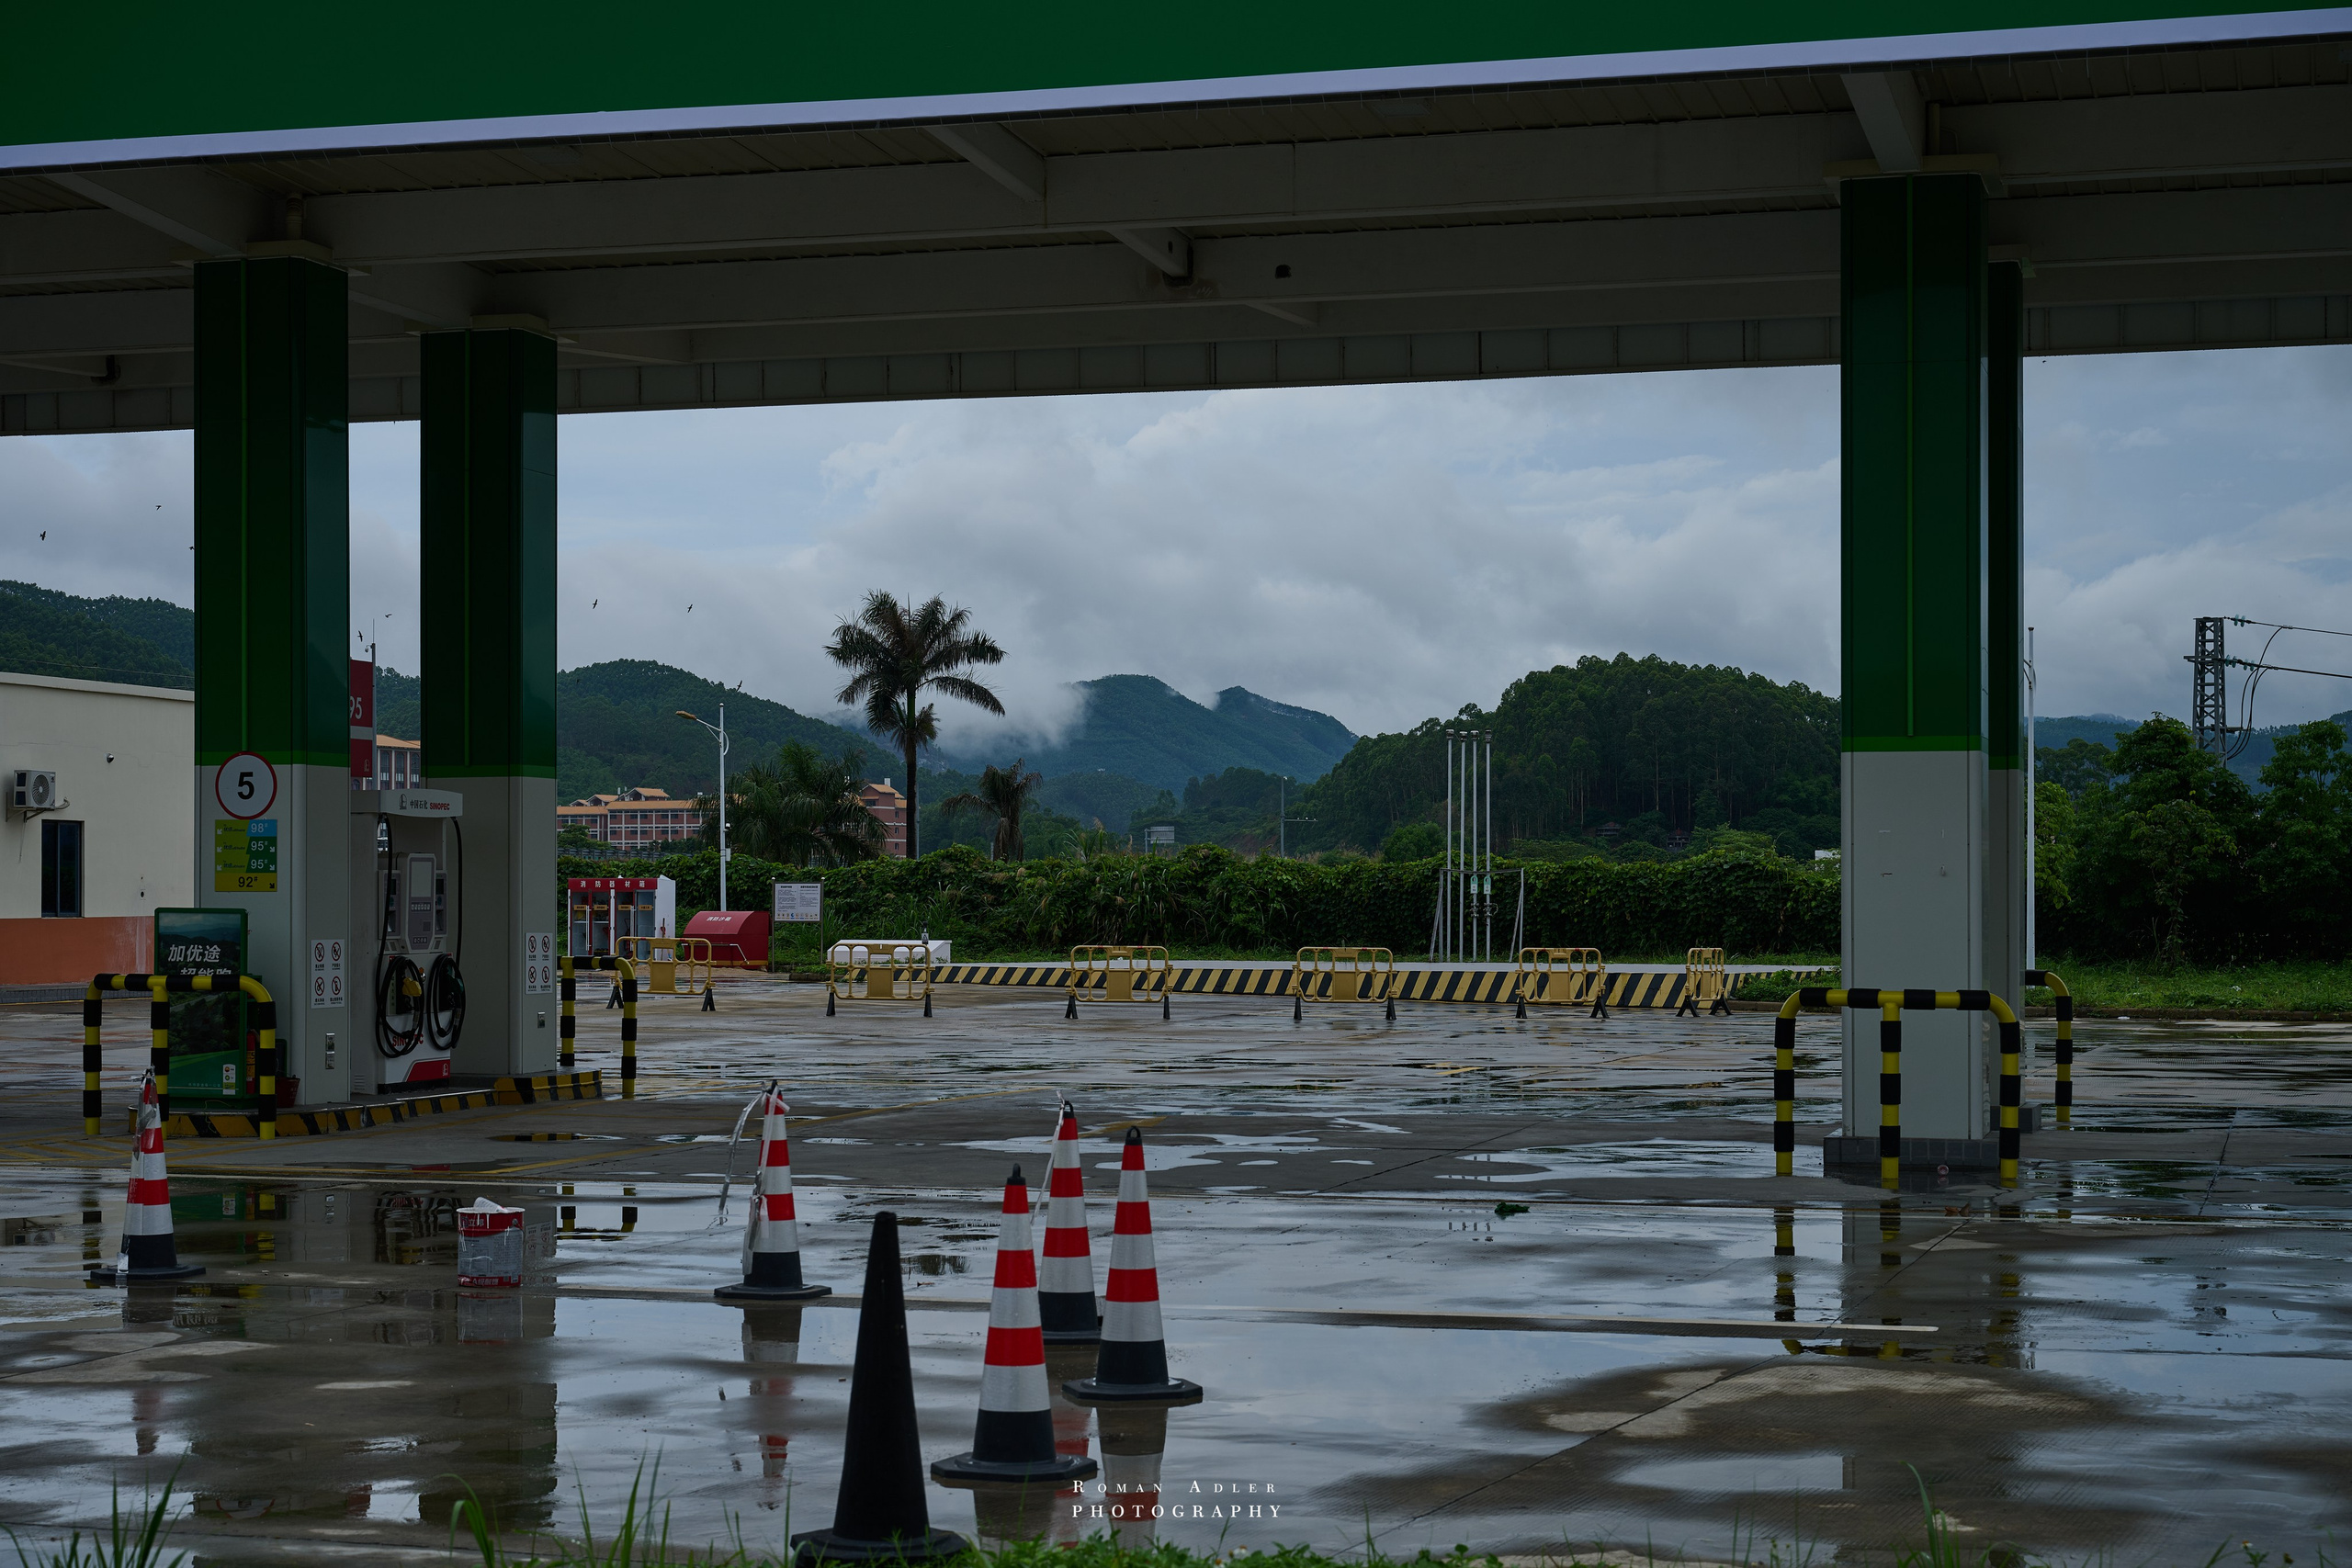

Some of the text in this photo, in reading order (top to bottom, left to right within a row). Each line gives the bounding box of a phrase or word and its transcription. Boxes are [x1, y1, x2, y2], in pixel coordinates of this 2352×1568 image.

[237, 772, 254, 800] 5
[429, 802, 450, 810] SINOPEC
[167, 944, 221, 963] 加优途
